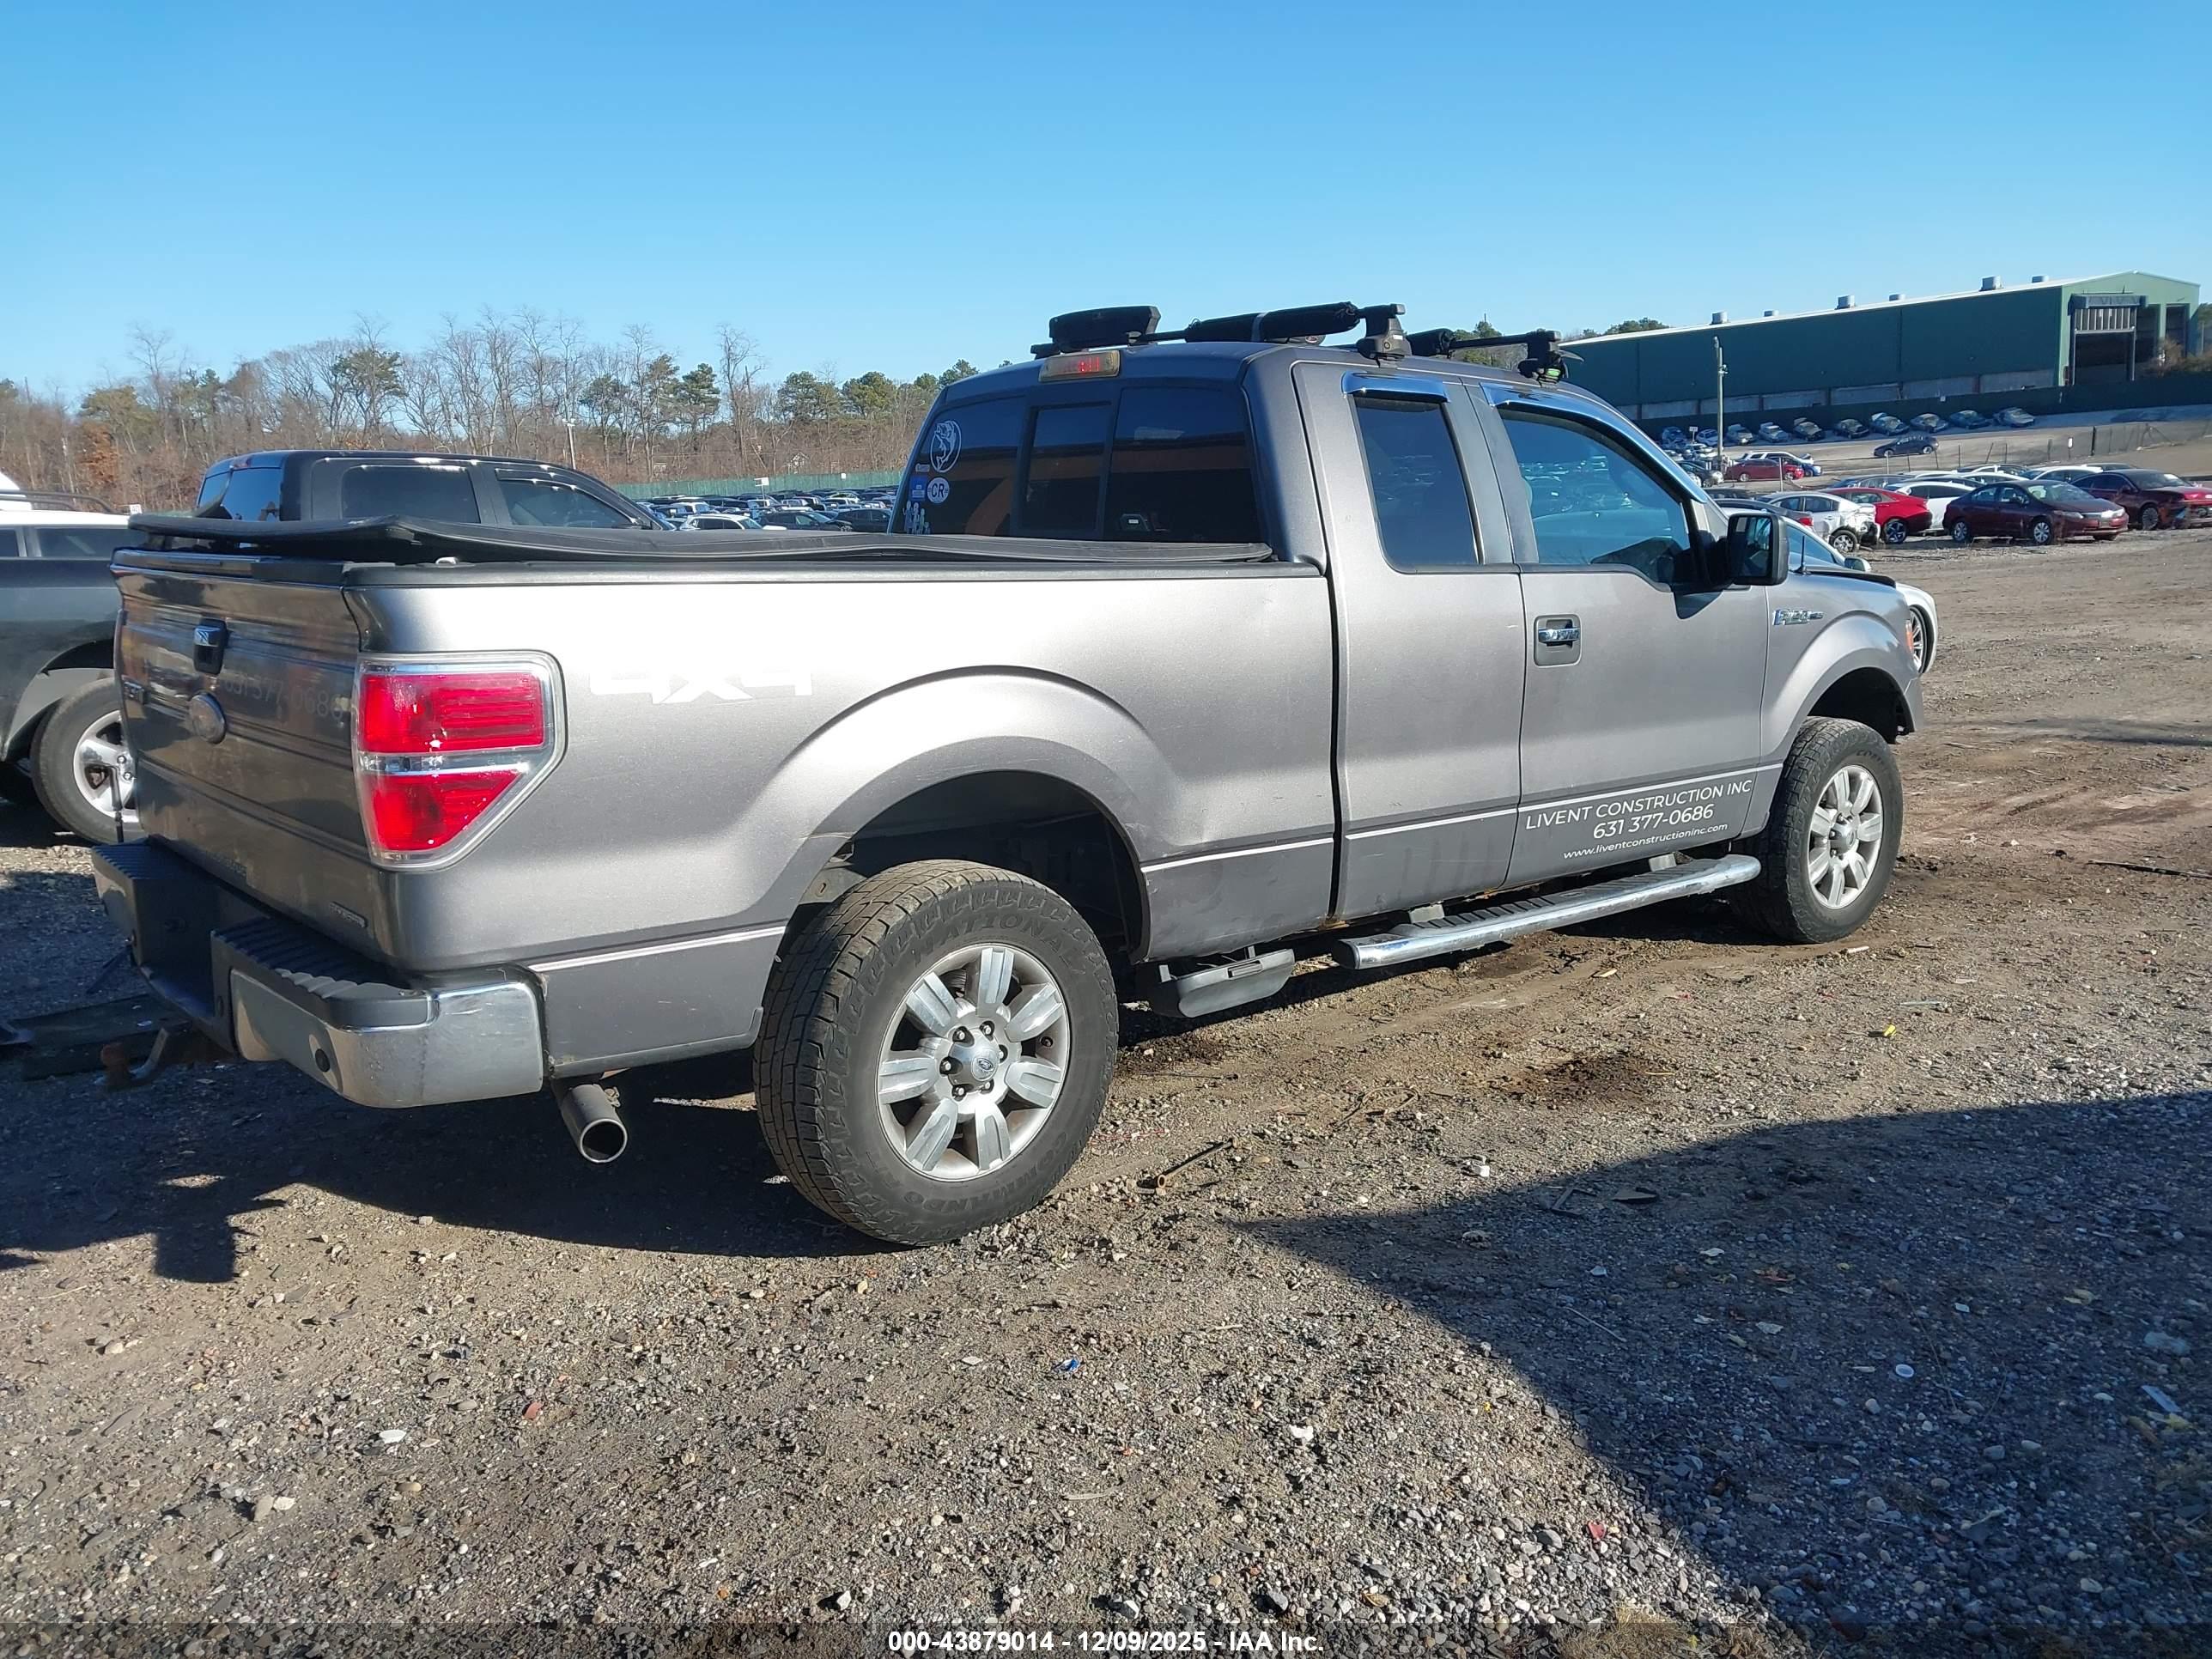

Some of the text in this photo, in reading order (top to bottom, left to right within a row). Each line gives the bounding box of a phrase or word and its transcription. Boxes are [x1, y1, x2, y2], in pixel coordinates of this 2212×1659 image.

[932, 482, 945, 498] CR
[1526, 780, 1753, 830] LIVENT CONSTRUCTION INC
[1593, 804, 1715, 839] 631 377-0686
[1563, 823, 1728, 860] www.liventconstructioninc.com
